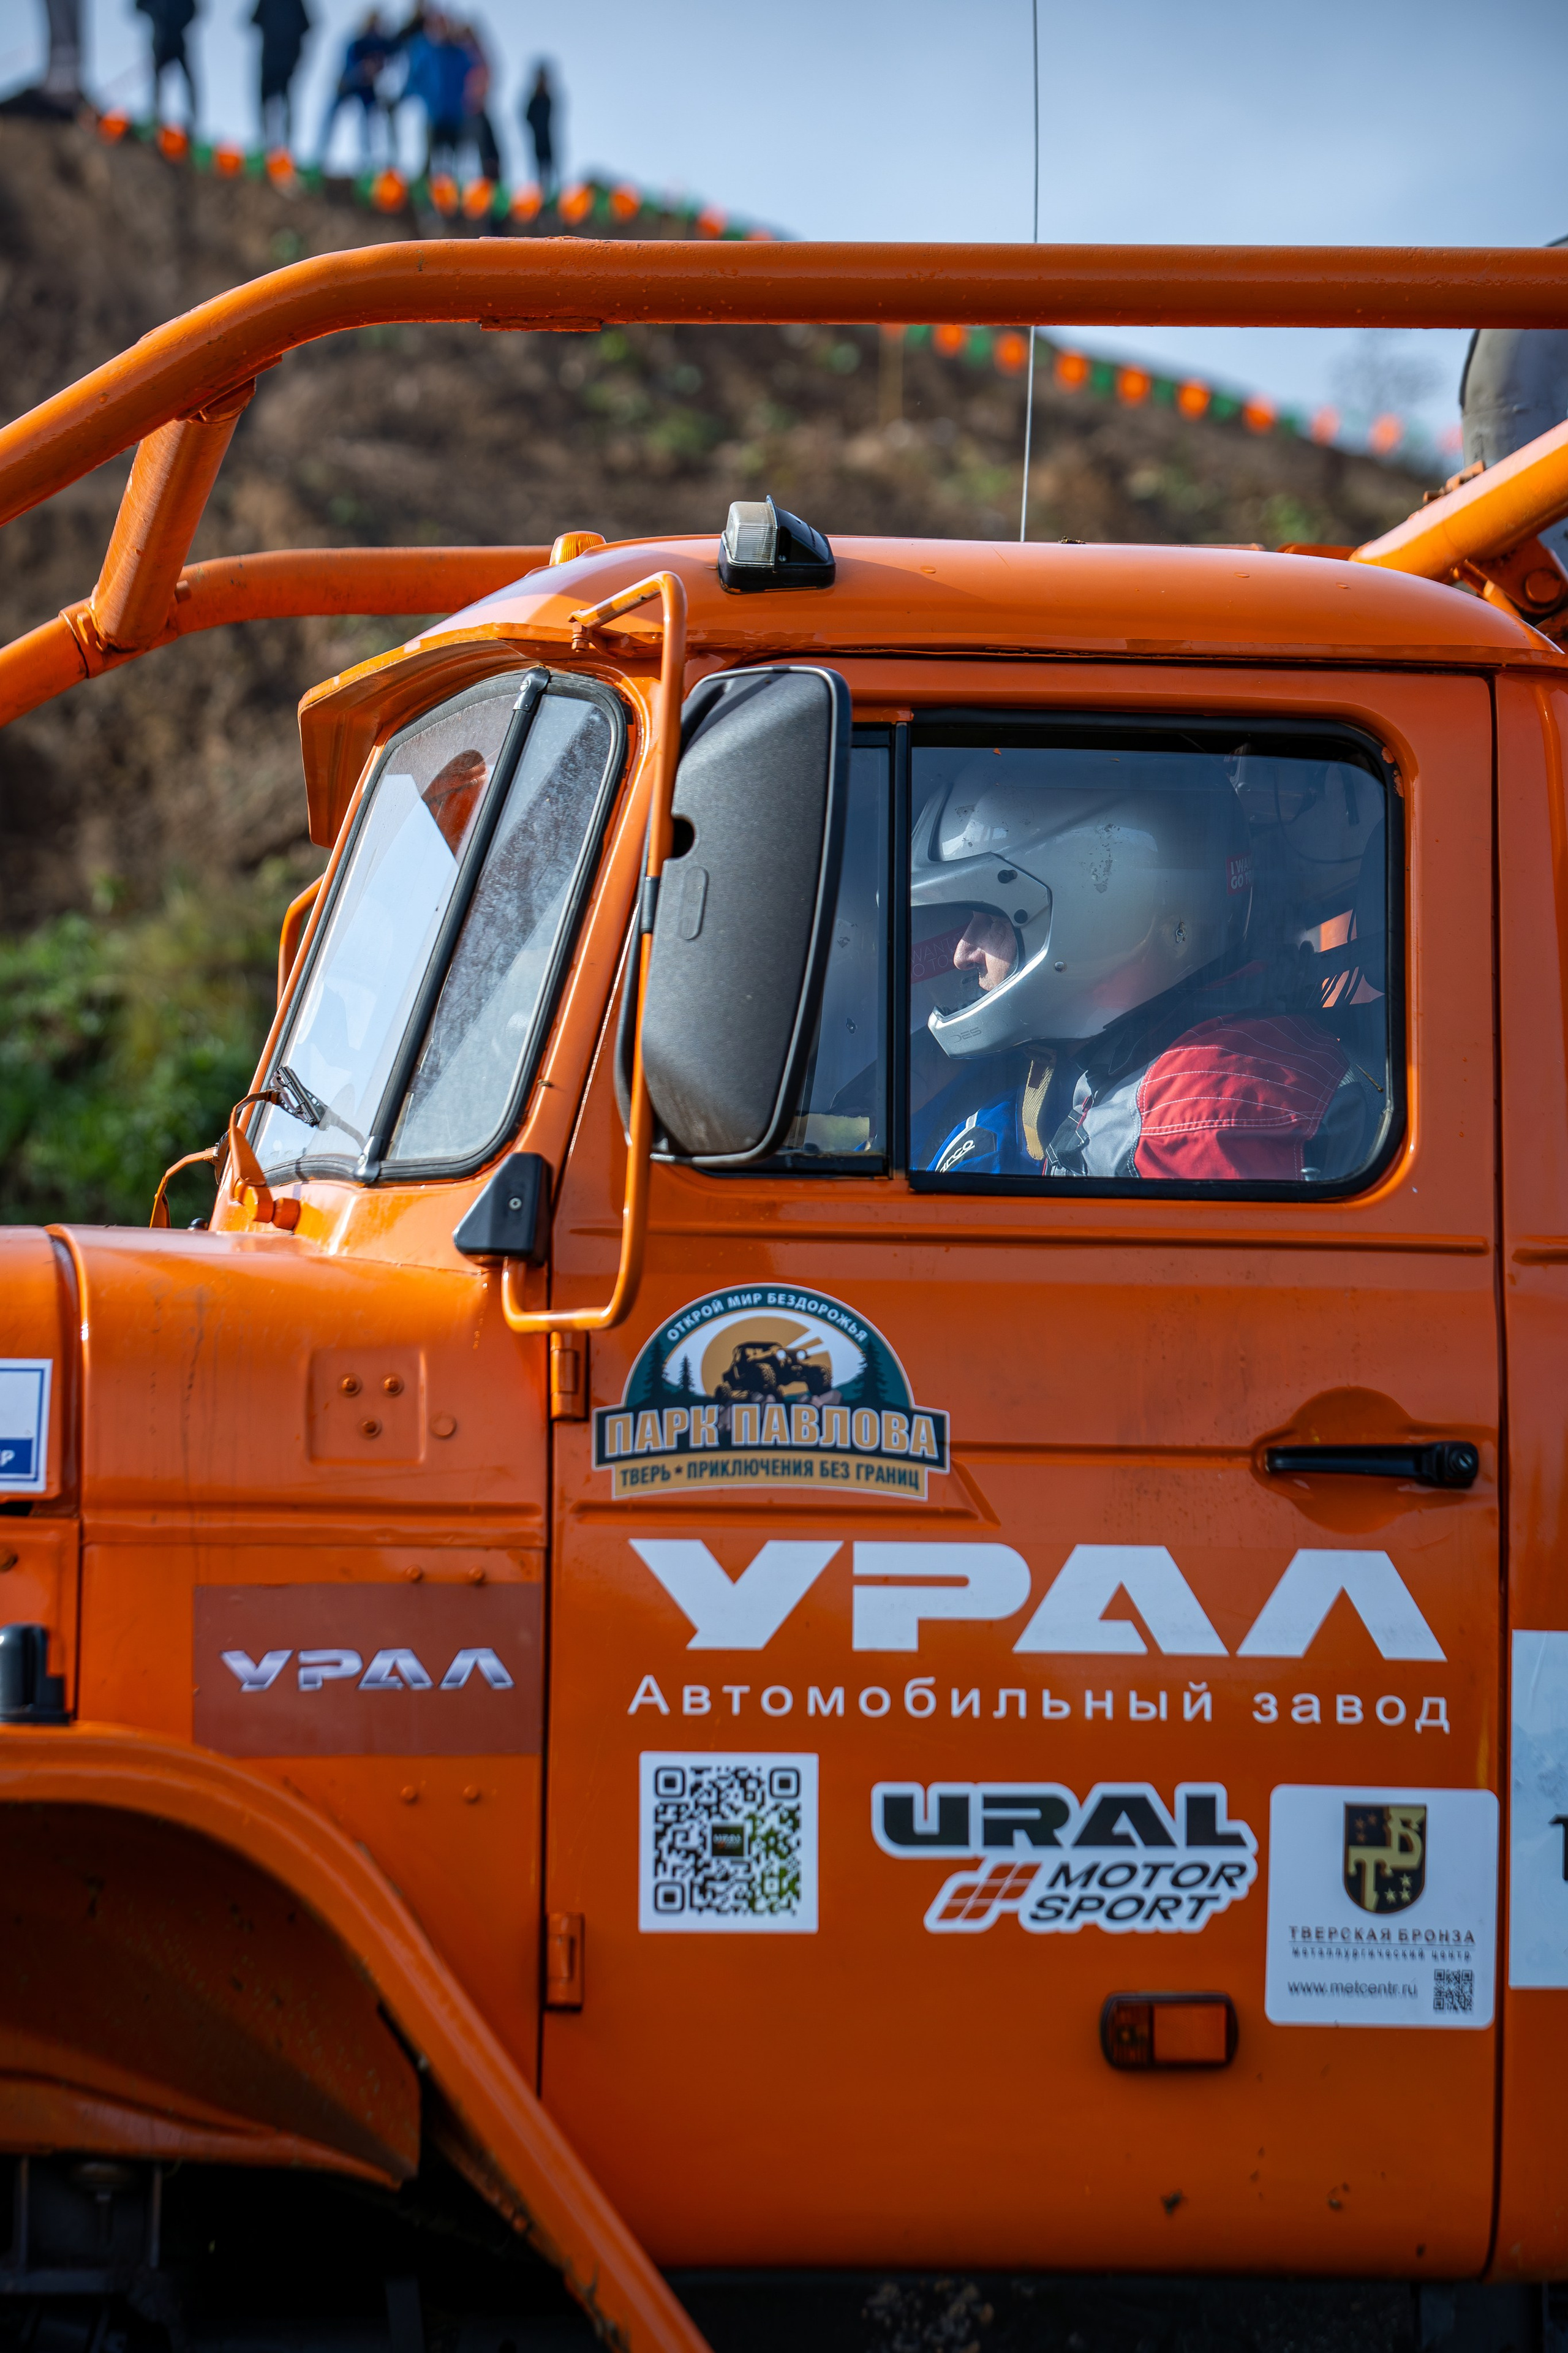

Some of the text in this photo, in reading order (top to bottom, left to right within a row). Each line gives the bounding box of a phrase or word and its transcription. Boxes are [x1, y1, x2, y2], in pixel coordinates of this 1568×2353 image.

[1231, 874, 1243, 889] GO
[927, 954, 948, 971] TO
[667, 1293, 869, 1343] ОТКРОЙ МИР БЕЗДОРОЖЬЯ
[605, 1403, 940, 1460] ПАРК ПАВЛОВА
[620, 1459, 919, 1491] ТВЕРЬ ПРИКЛЮЧЕНИЯ БЕЗ ГРАНИЦ
[628, 1538, 1448, 1662] УРАЛ
[219, 1647, 515, 1692] УРАЛ
[627, 1674, 1450, 1734] Автомобильный завод
[883, 1792, 1248, 1847] URAL
[1047, 1860, 1248, 1890] MOTOR
[1029, 1893, 1221, 1922] SPORT
[1288, 1925, 1475, 1943] ТВЕРСКАЯ БРОНЗА
[1431, 1949, 1471, 1962] центр
[1287, 1980, 1418, 1998] www.metcentr.ru
